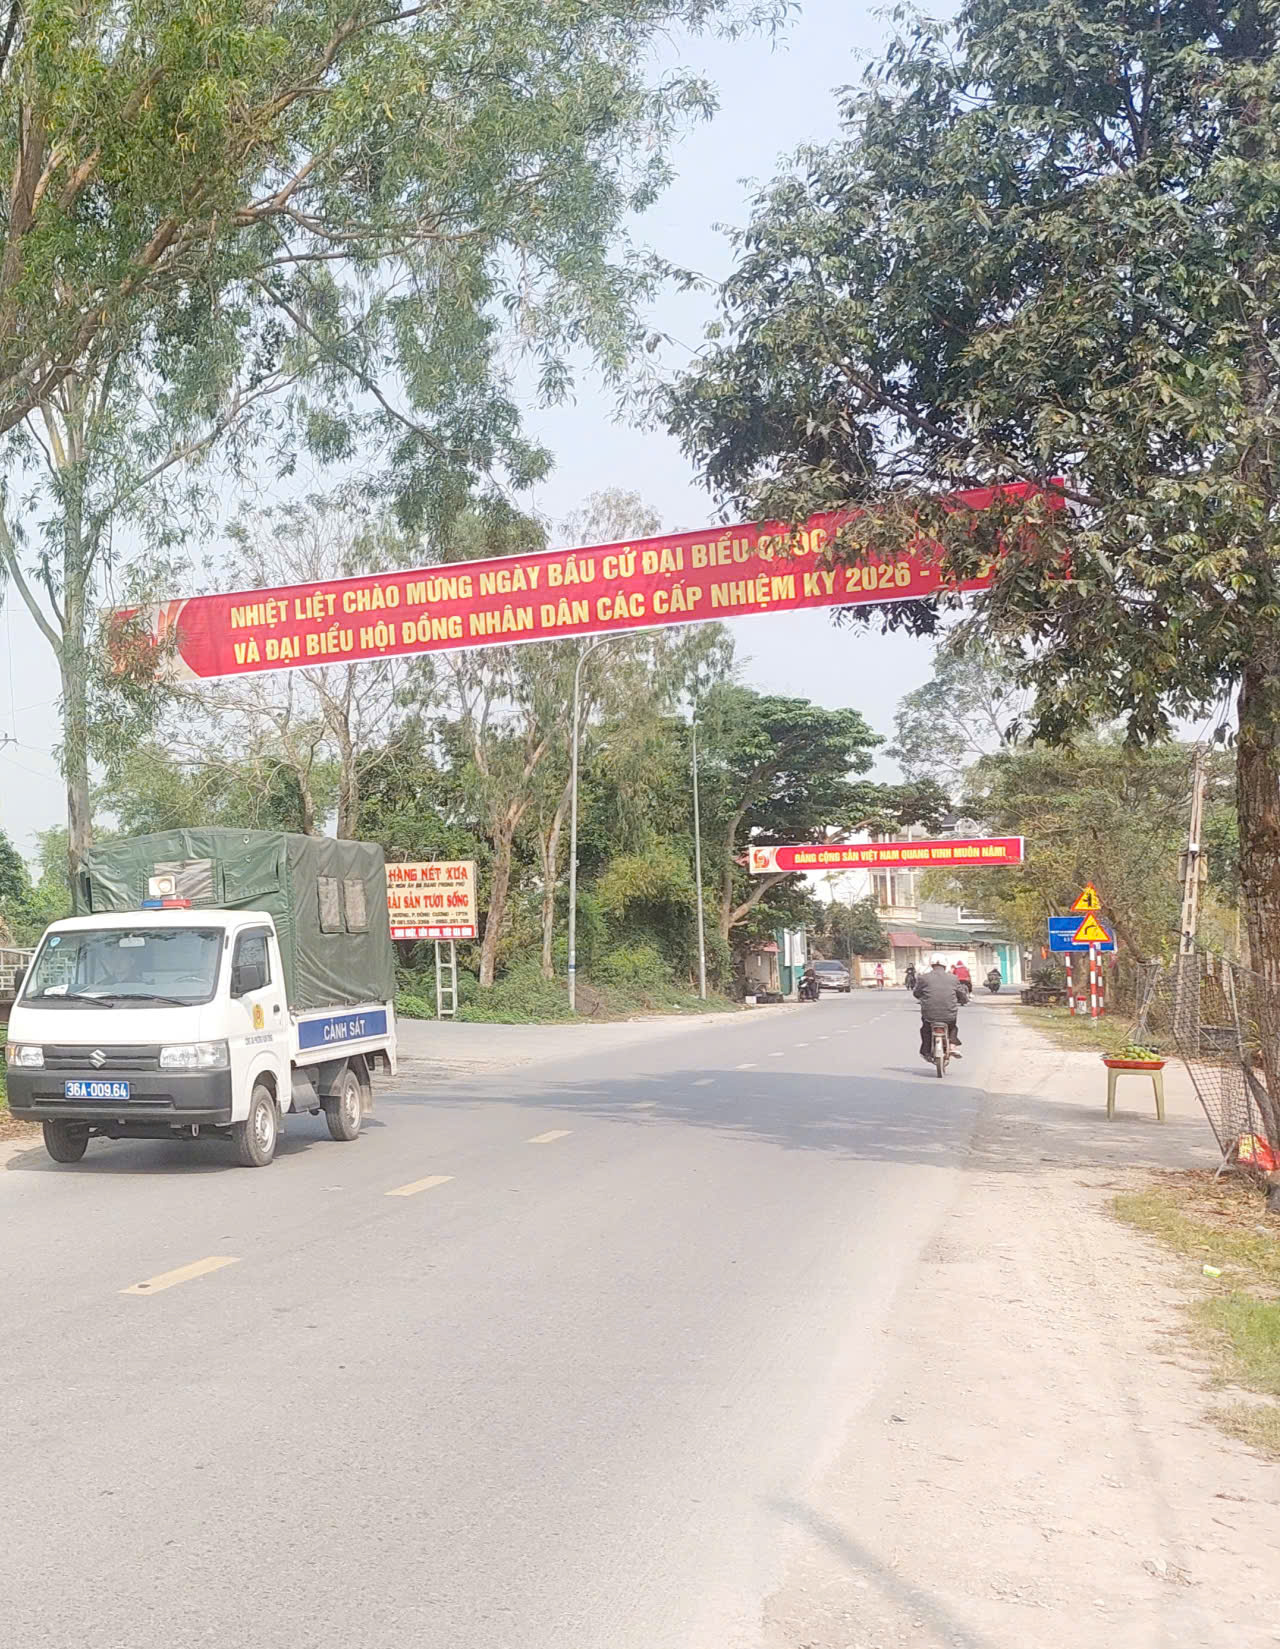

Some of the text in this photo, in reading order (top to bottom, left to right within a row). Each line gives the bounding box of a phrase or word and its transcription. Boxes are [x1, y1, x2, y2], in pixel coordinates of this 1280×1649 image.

[230, 598, 289, 630] NHIỆT
[294, 590, 336, 623] LIỆT
[342, 583, 401, 613] CHÀO
[405, 574, 473, 605] MỪNG
[479, 565, 540, 597] NGÀY
[548, 555, 595, 588] BẦU
[602, 543, 636, 582] CỬ
[641, 540, 685, 576] ĐẠI
[691, 529, 749, 569] BIỂU
[234, 634, 261, 666] VÀ
[265, 630, 302, 665] ĐẠI
[306, 621, 355, 657] BIỂU
[360, 616, 397, 653] HỘI
[401, 609, 463, 645] ĐỒNG
[469, 603, 535, 636] NHÂN
[541, 596, 590, 629] DÂN
[596, 585, 645, 621] CÁC
[653, 577, 703, 615] CẤP
[710, 571, 797, 608] NHIỆM
[845, 561, 912, 593] 2026
[818, 851, 840, 864] CỘNG
[842, 848, 859, 861] SẢN
[861, 849, 878, 863] VIỆT
[880, 849, 899, 860] NAM
[901, 848, 930, 861] QUANG
[931, 848, 952, 859] VINH
[953, 845, 980, 858] MUÔN
[388, 865, 468, 882] HÀNG NÉT XƯA
[403, 891, 421, 909] SẢN
[423, 894, 444, 908] TƯƠI
[447, 890, 469, 908] SỐNG
[324, 1015, 366, 1041] CẢNH SÁT
